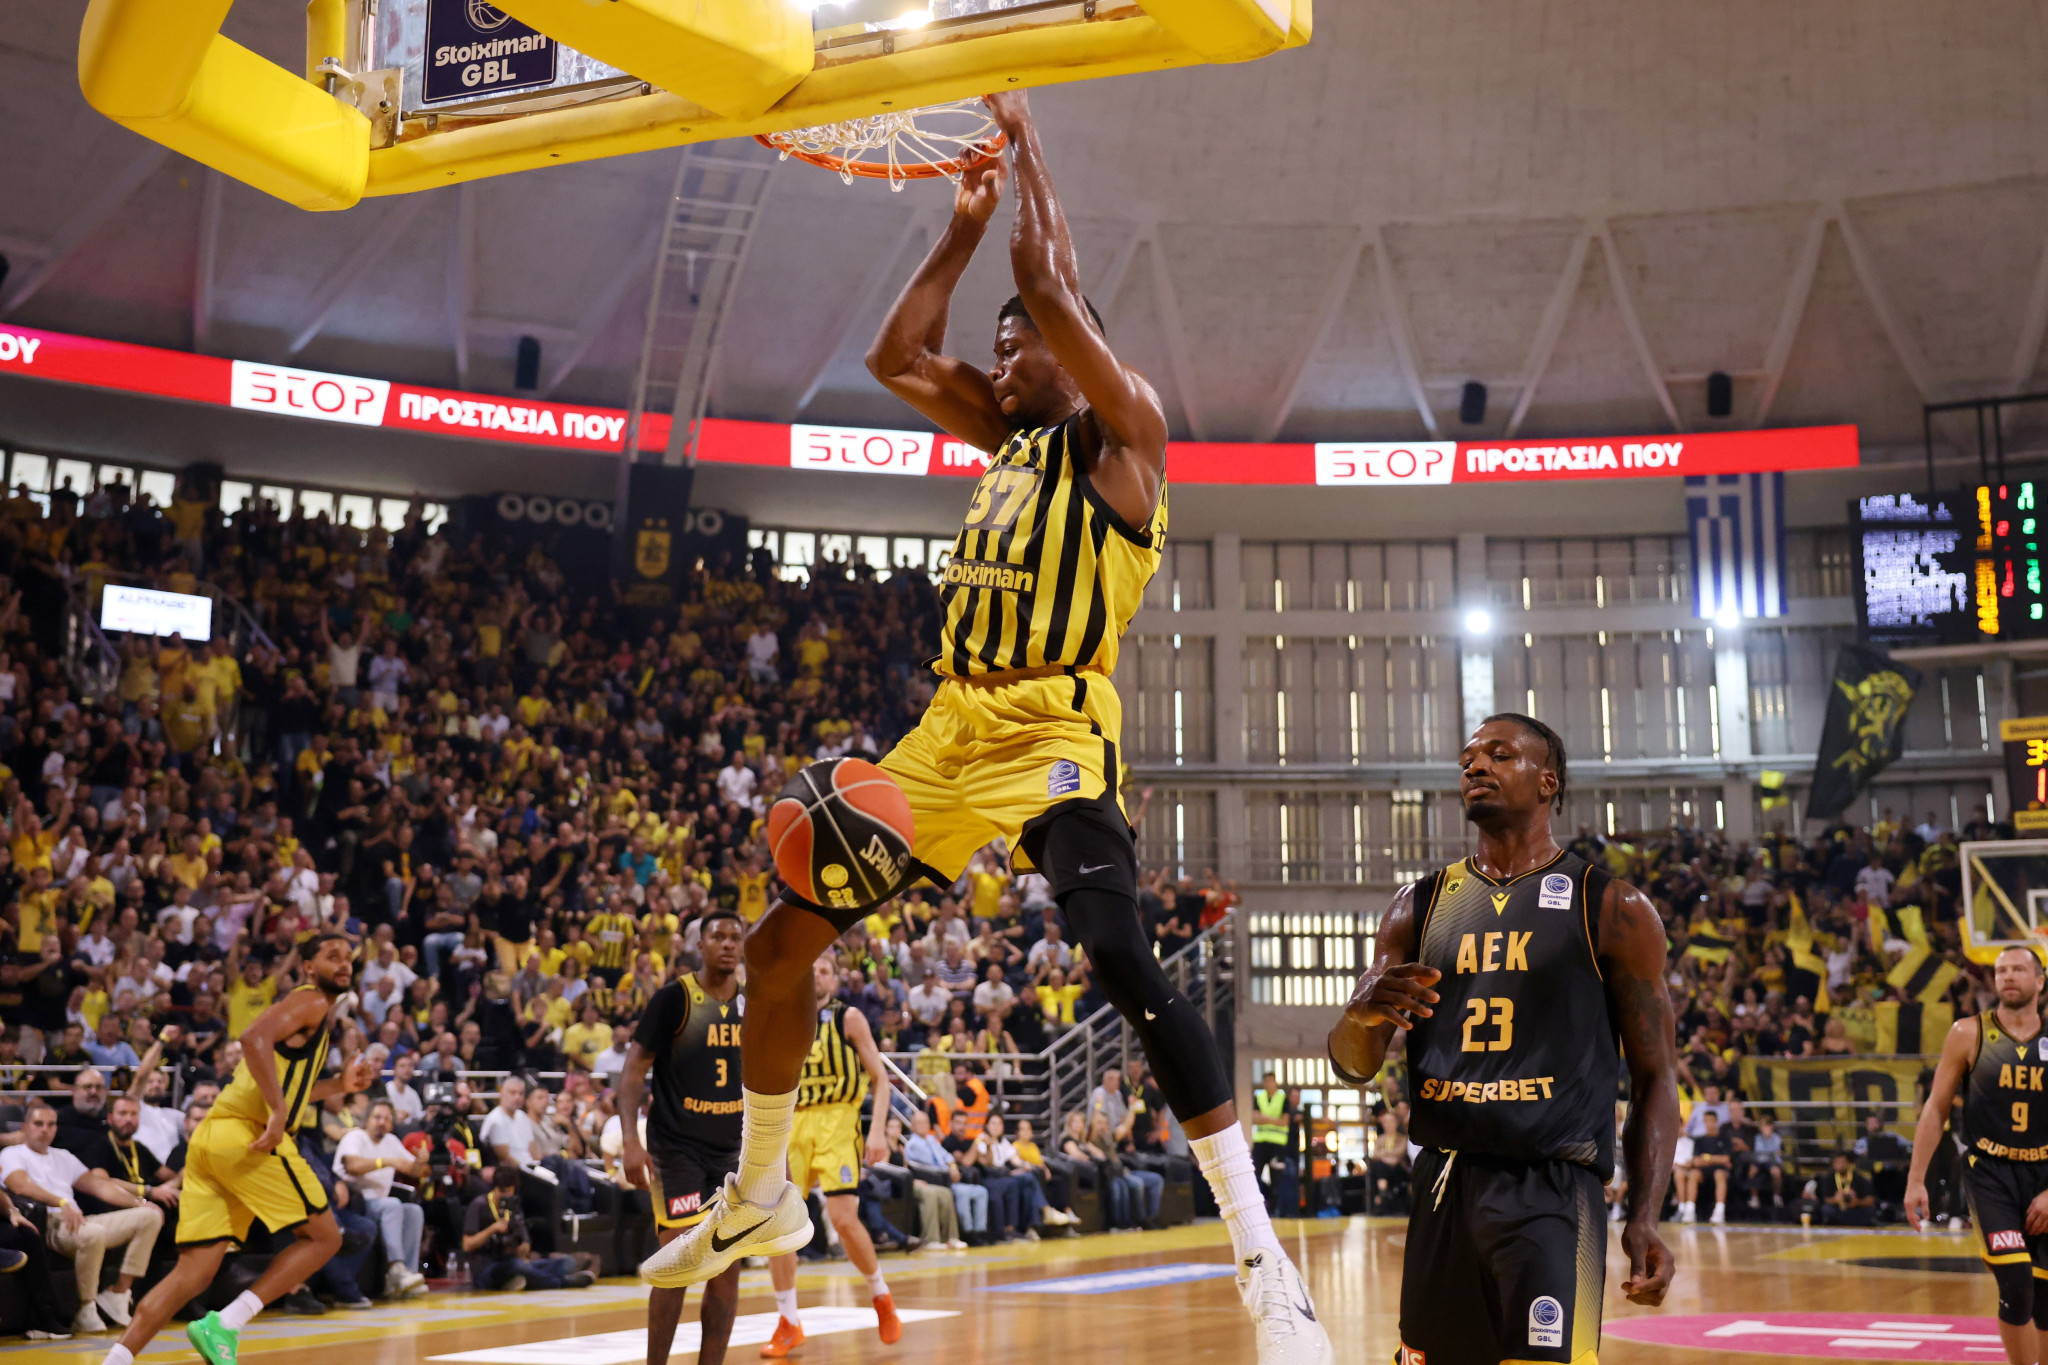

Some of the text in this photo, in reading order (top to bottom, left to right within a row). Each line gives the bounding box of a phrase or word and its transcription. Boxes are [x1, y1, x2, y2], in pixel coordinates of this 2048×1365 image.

[435, 34, 547, 67] Stoiximan
[461, 59, 517, 87] GBL
[0, 333, 40, 363] ΟΥ
[251, 371, 375, 415] STOP
[400, 392, 627, 442] ΠΡΟΣΤΑΣΙΑ ΠΟΥ
[808, 433, 919, 466] STOP
[1333, 449, 1443, 478] STOP
[1466, 443, 1683, 473] ΠΡΟΣΤΑΣΙΑ ΠΟΥ
[965, 470, 1038, 525] 37
[1456, 931, 1534, 974] AEK
[707, 1023, 742, 1047] AEK
[1461, 997, 1514, 1052] 23
[715, 1058, 727, 1087] 3
[1999, 1063, 2044, 1091] AEK
[1420, 1076, 1555, 1103] SUPERBET
[683, 1097, 744, 1114] SUPERBE
[2011, 1101, 2029, 1133] 9
[1976, 1137, 2048, 1162] SUPERBE
[671, 1192, 700, 1214] AVIS
[1992, 1231, 2025, 1249] AVIS
